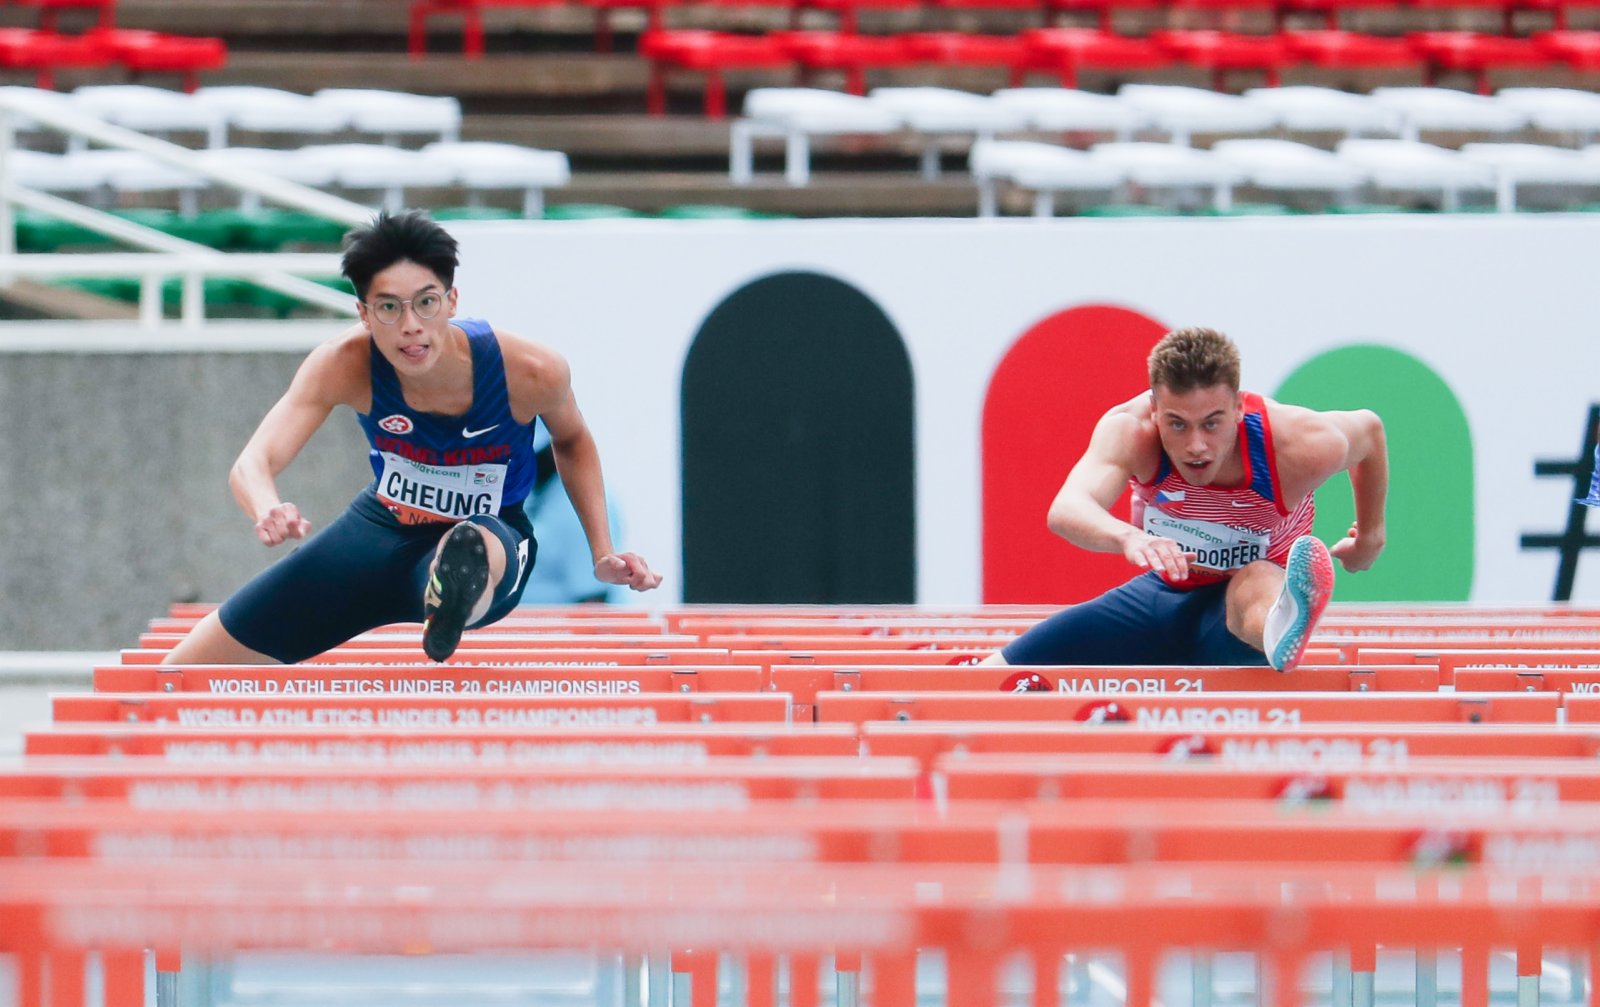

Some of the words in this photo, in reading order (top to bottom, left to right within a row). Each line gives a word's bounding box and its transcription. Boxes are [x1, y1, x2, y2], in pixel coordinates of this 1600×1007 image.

[387, 471, 491, 517] CHEUNG
[1161, 520, 1223, 544] safaricom
[209, 679, 278, 695] WORLD
[282, 679, 385, 695] ATHLETICS
[389, 679, 455, 695] UNDER
[460, 679, 480, 695] 20
[485, 679, 641, 695] CHAMPIONSHIPS
[1058, 678, 1165, 694] NAIROBI
[1174, 678, 1203, 694] 21
[178, 707, 258, 727] WORLD
[261, 707, 374, 727] ATHLETICS
[378, 707, 451, 727] UNDER
[455, 707, 481, 727] 20
[484, 707, 658, 727] CHAMPIONSHIPS
[1137, 706, 1260, 730] NAIROBI
[1266, 706, 1301, 730] 21
